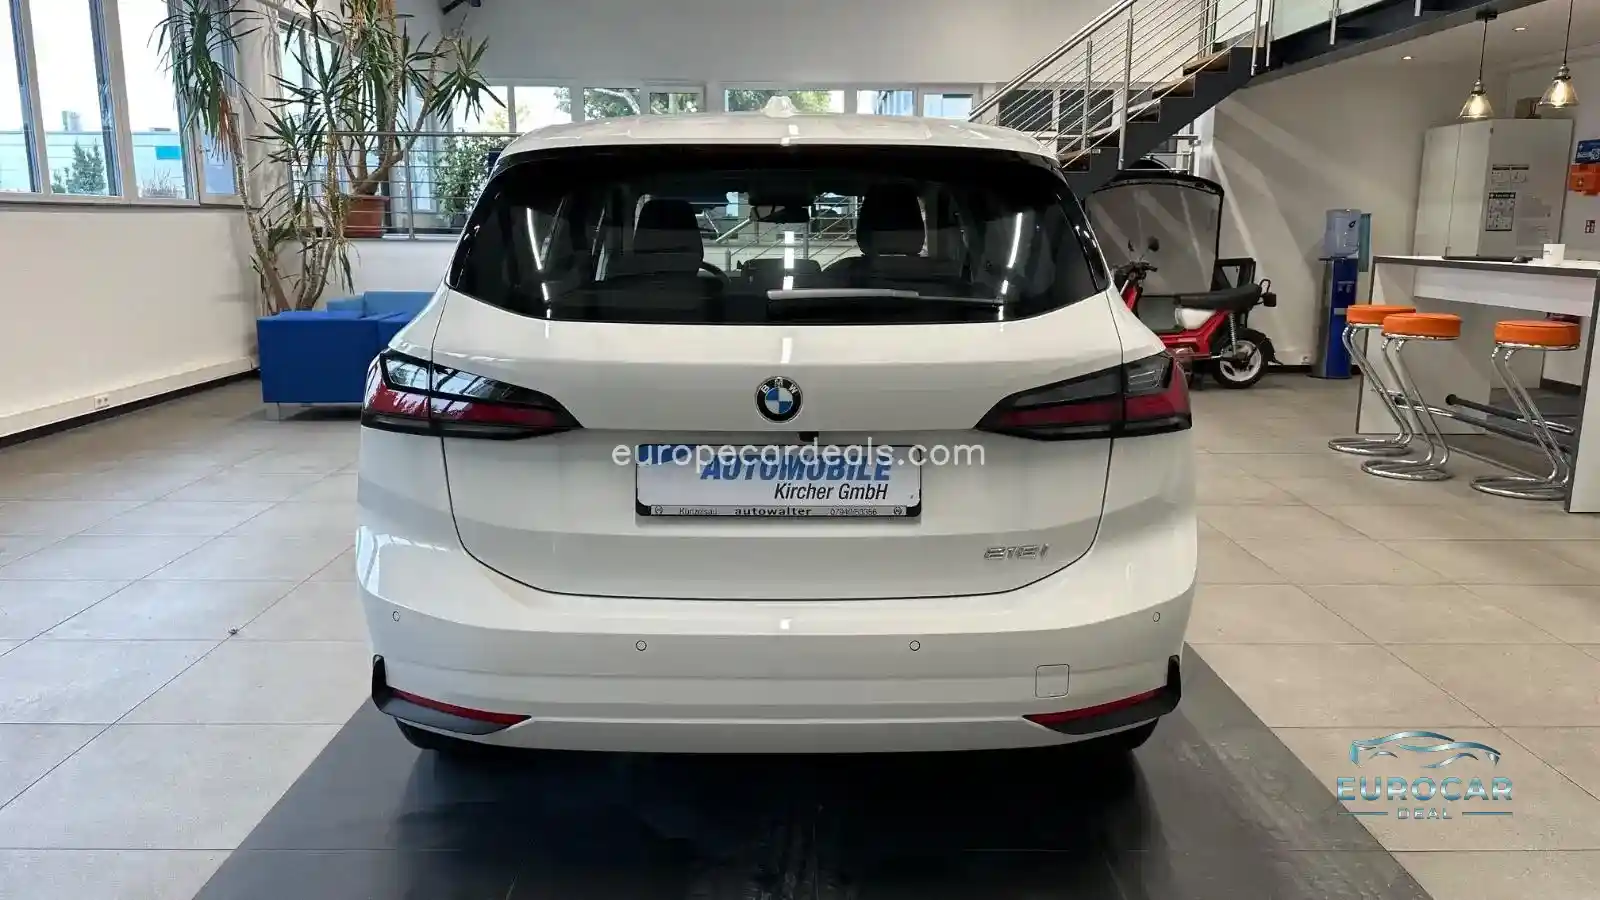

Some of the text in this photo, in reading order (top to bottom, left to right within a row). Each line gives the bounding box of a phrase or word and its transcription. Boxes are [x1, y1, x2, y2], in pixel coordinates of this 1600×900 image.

[760, 376, 798, 394] BMW
[700, 454, 892, 481] AUTOMOBILE
[774, 483, 889, 500] Kircher GmbH
[734, 506, 813, 515] autowalter
